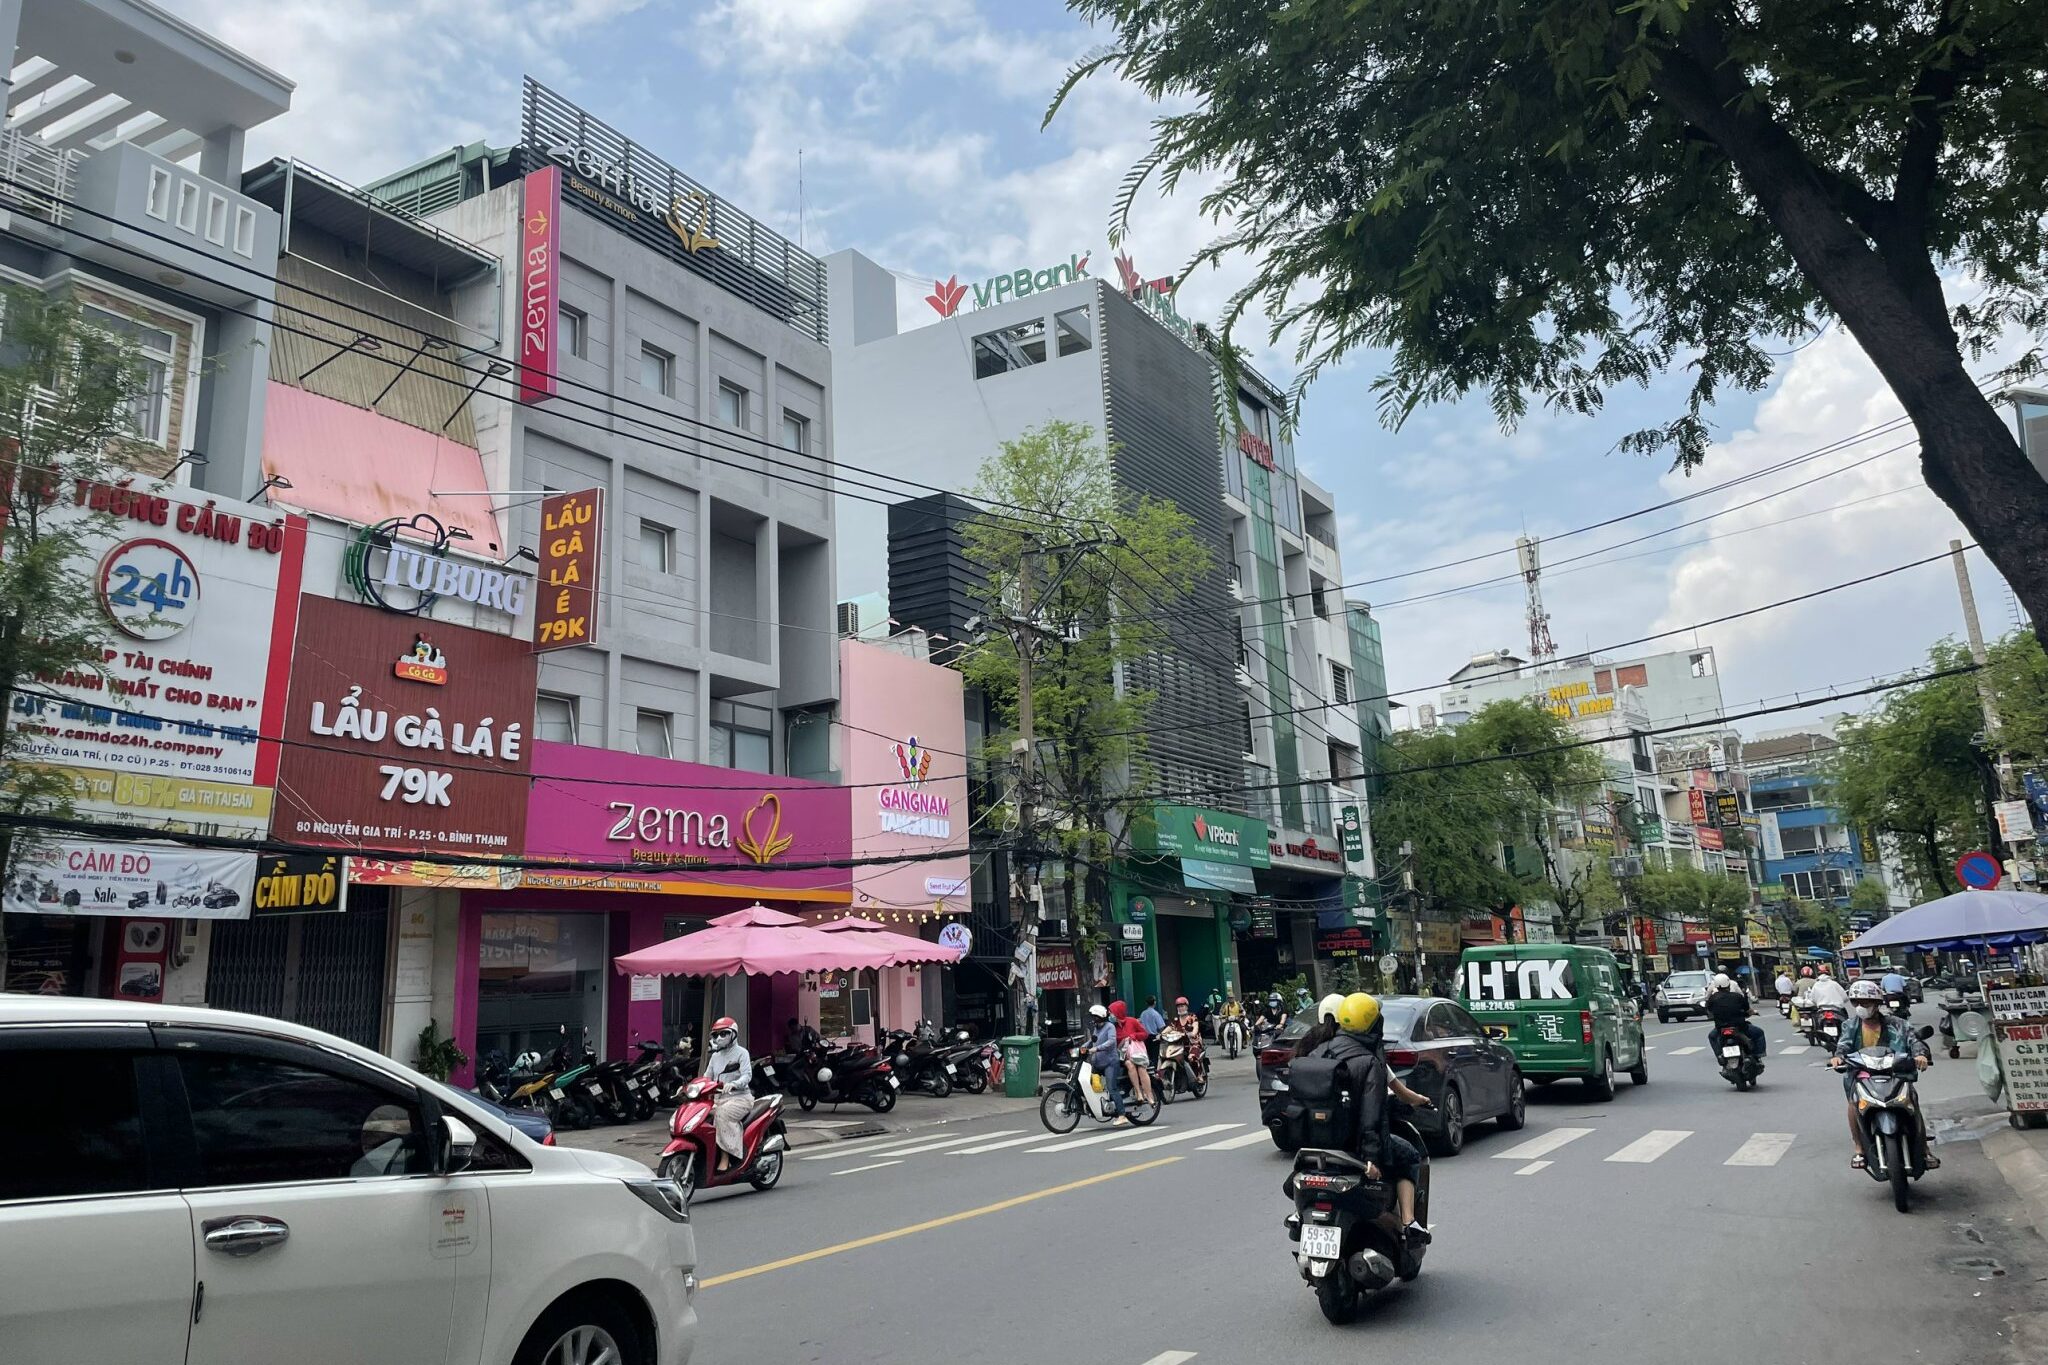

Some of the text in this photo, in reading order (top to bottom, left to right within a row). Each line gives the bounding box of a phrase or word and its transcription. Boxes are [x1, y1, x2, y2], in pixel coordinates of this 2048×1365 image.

[570, 177, 604, 207] Beauty
[613, 201, 637, 223] more
[973, 250, 1091, 307] VPBank
[545, 498, 592, 532] LẨU
[550, 530, 584, 558] GÀ
[110, 559, 191, 612] 24h
[383, 542, 527, 617] TUBORG
[550, 560, 580, 587] LÁ
[556, 589, 569, 615] É
[539, 617, 586, 643] 79K
[124, 651, 213, 681] TÀI CHÍNH
[165, 687, 202, 706] CHO
[207, 692, 243, 712] BẠN
[310, 686, 521, 761] LẨU GÀ LÁ É
[62, 748, 79, 757] GIA
[150, 759, 169, 768] P.25
[213, 765, 252, 777] 35106143
[115, 774, 175, 811] 85%
[379, 765, 454, 807] 79K
[879, 787, 949, 815] GANGNAM
[296, 821, 311, 833] 80
[313, 819, 360, 836] NGUYỄN
[362, 825, 381, 838] GIA
[384, 824, 402, 839] TRÍ
[408, 828, 431, 840] P.25
[475, 833, 508, 848] THẠNH
[879, 812, 950, 839] TANGHULU
[1207, 825, 1239, 846] VPBank
[632, 847, 670, 865] Beauty
[684, 853, 709, 865] more
[93, 887, 117, 903] Sale
[255, 856, 336, 909] CẦM ĐỒ
[930, 882, 941, 890] Sweet
[1994, 1003, 2011, 1012] RAU
[2027, 990, 2046, 999] CAM
